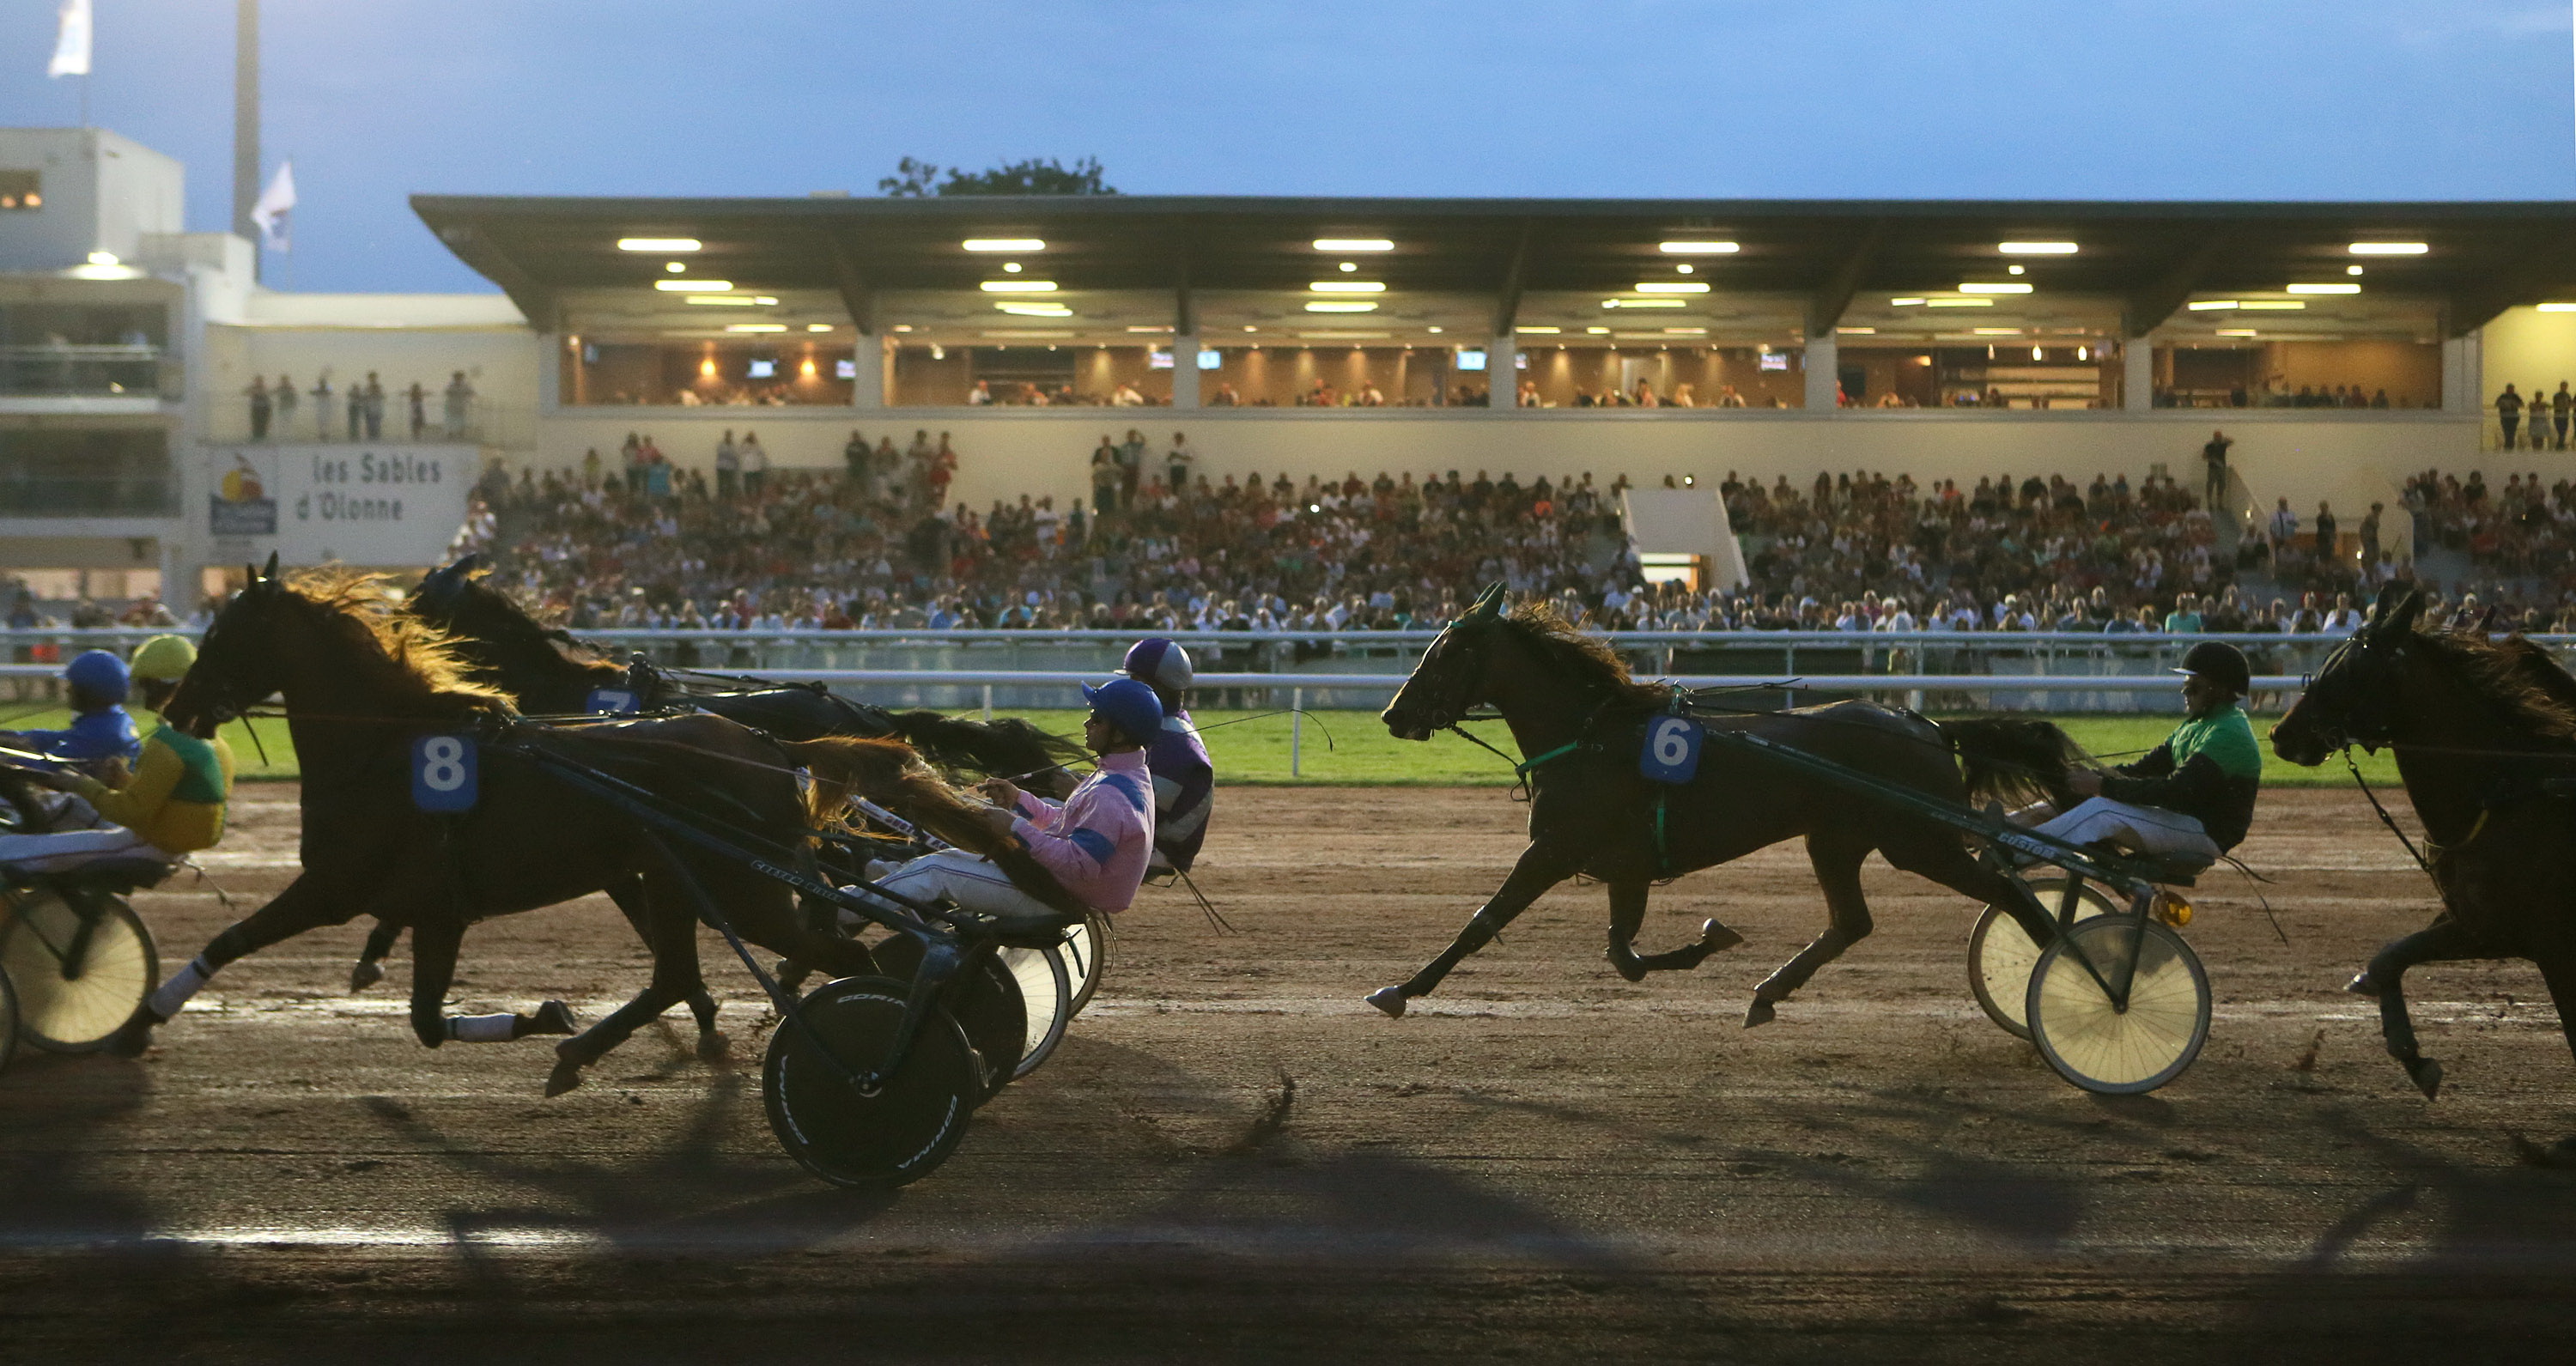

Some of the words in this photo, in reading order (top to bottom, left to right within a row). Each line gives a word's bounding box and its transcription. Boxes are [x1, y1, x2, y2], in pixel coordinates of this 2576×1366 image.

[313, 454, 348, 483] les
[361, 452, 442, 484] Sables
[598, 690, 631, 714] 7
[423, 736, 465, 792] 8
[1653, 718, 1691, 766] 6
[897, 1094, 957, 1169] CORIMA
